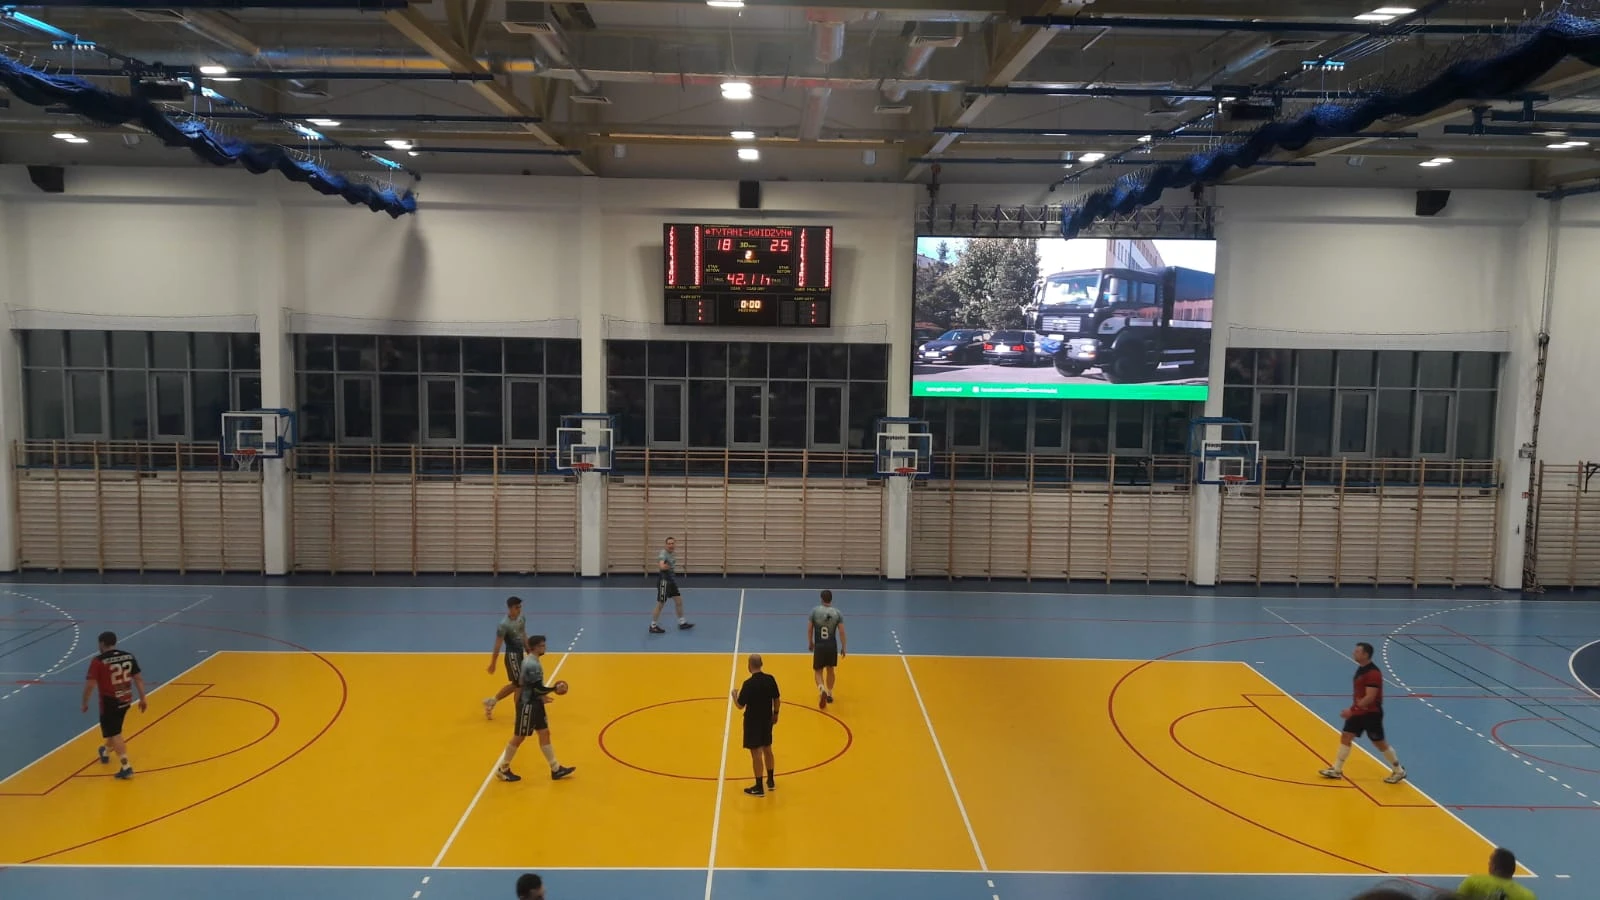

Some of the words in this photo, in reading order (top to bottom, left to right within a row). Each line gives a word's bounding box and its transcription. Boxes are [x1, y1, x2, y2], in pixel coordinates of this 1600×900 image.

[717, 239, 731, 251] 18
[770, 239, 789, 252] 25
[744, 250, 753, 260] 2
[820, 626, 829, 640] 8
[109, 660, 132, 685] 22
